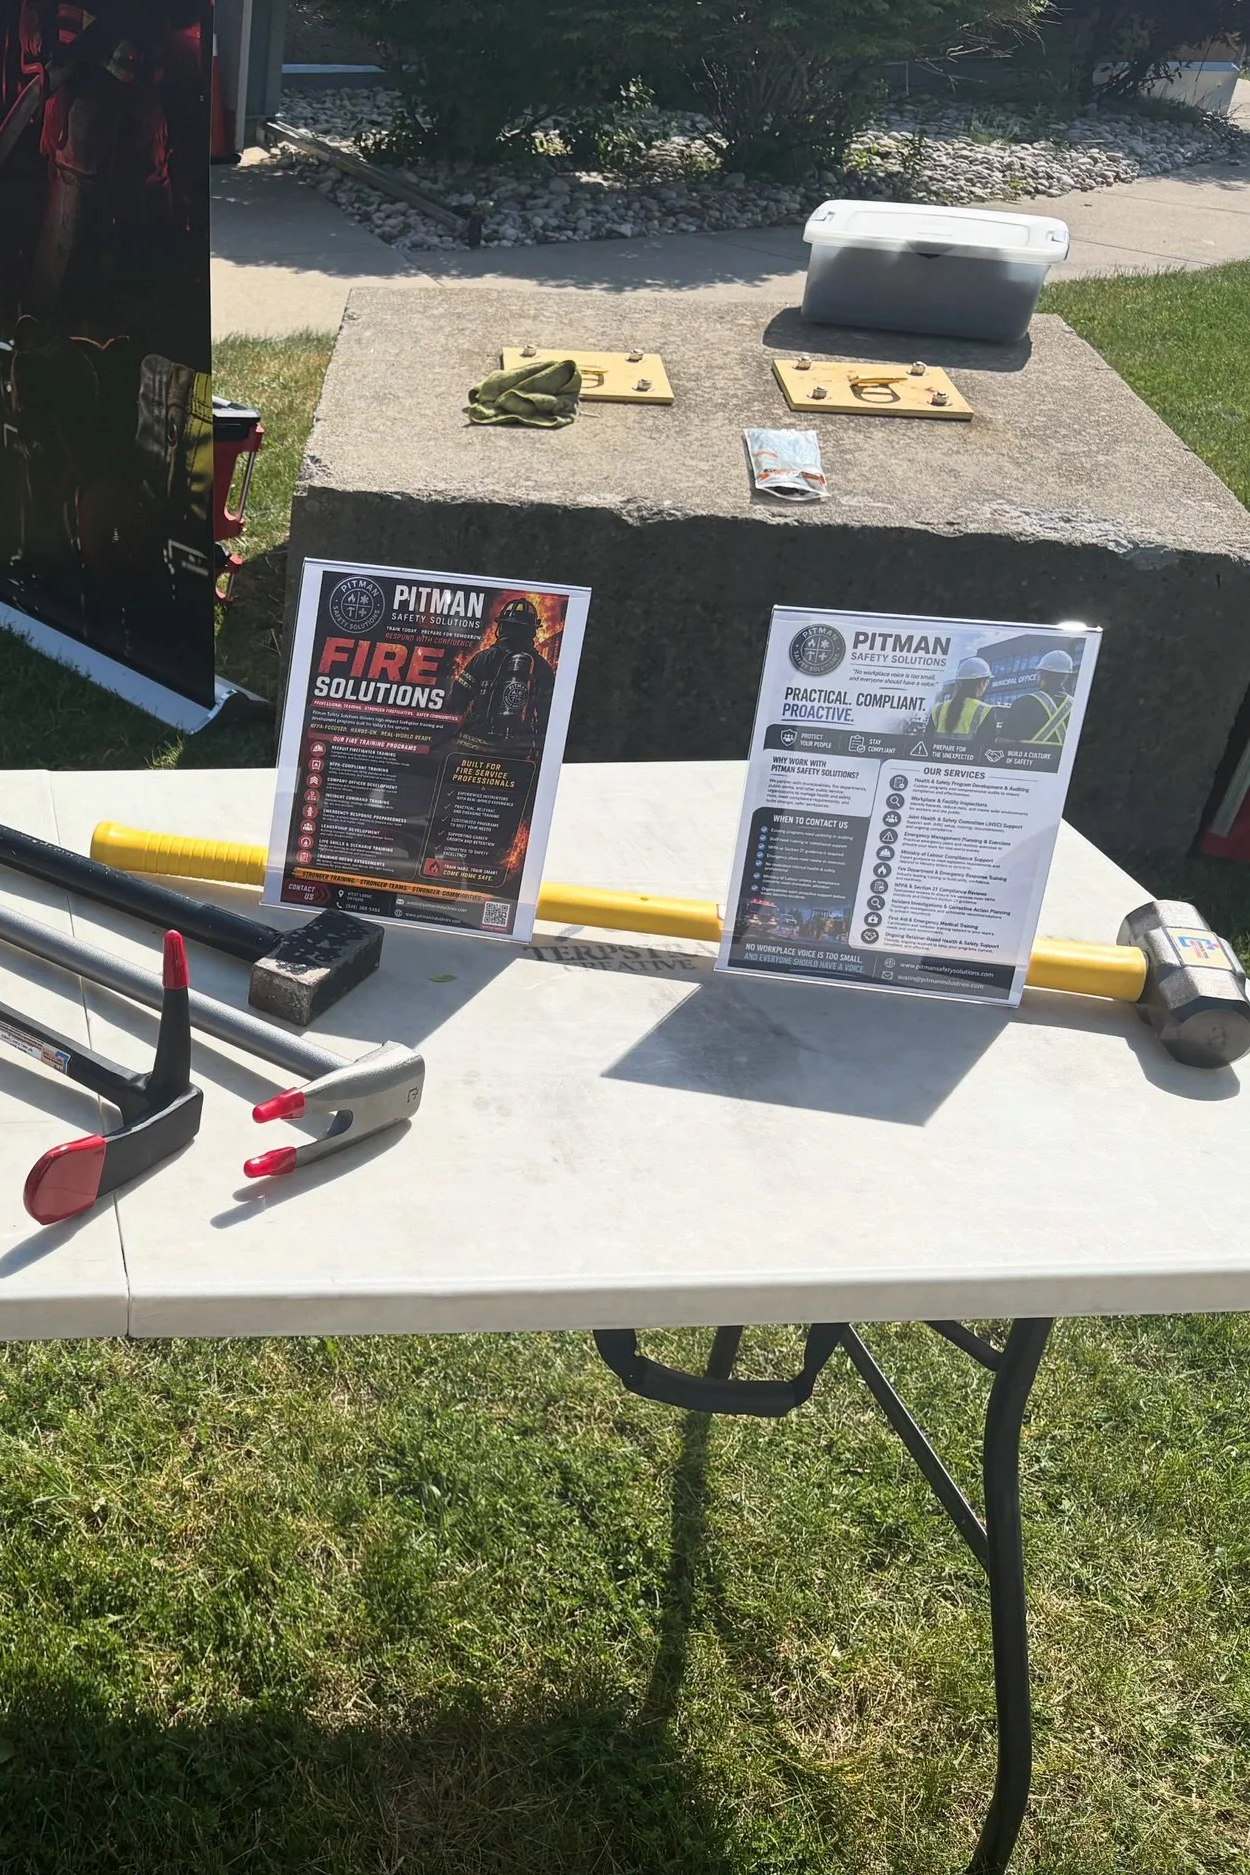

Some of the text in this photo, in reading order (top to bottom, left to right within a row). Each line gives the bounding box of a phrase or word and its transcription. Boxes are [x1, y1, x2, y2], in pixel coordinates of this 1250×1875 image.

[340, 578, 379, 596] PITMAN
[392, 584, 485, 618] PITMAN
[330, 605, 379, 632] SAFETY SOLUTIONS
[391, 612, 480, 628] SAFETY SOLUTIONS
[801, 626, 840, 640] PITMAN
[852, 631, 950, 655] PITMAN
[317, 635, 445, 686] FIRE
[850, 651, 947, 666] SAFETY SOLUTIONS
[863, 669, 890, 677] workplace
[1018, 674, 1037, 683] OFFICE
[314, 675, 445, 710] SOLUTIONS
[784, 687, 927, 711] PRACTICAL. COMPLIANT.
[782, 703, 855, 721] PROACTIVE.
[800, 732, 823, 740] PROTECT
[359, 739, 385, 747] TRAINING
[385, 742, 416, 751] PROGRAMS
[788, 757, 808, 765] WORK
[809, 759, 826, 767] WITH
[942, 752, 973, 760] UNEXPECTED
[461, 760, 483, 768] BUILT
[474, 769, 508, 779] SERVICE
[770, 764, 859, 779] PITMAN SAFETY SOLUTIONS?
[923, 767, 985, 779] OUR SERVICES
[452, 774, 515, 788] PROFESSIONALS
[971, 782, 1003, 790] Development
[773, 814, 793, 823] WHEN
[805, 818, 837, 827] CONTACT
[288, 883, 315, 892] CONTACT
[756, 944, 795, 955] WORKPLACE
[797, 949, 815, 957] VOICE
[825, 952, 838, 960] TOO
[744, 952, 757, 960] AND
[760, 954, 792, 964] EVERYONE
[792, 958, 817, 967] SHOULD
[819, 961, 836, 969] HAVE
[844, 964, 865, 973] VOICE.
[899, 961, 994, 978] www.pitmansafetysolutions.com
